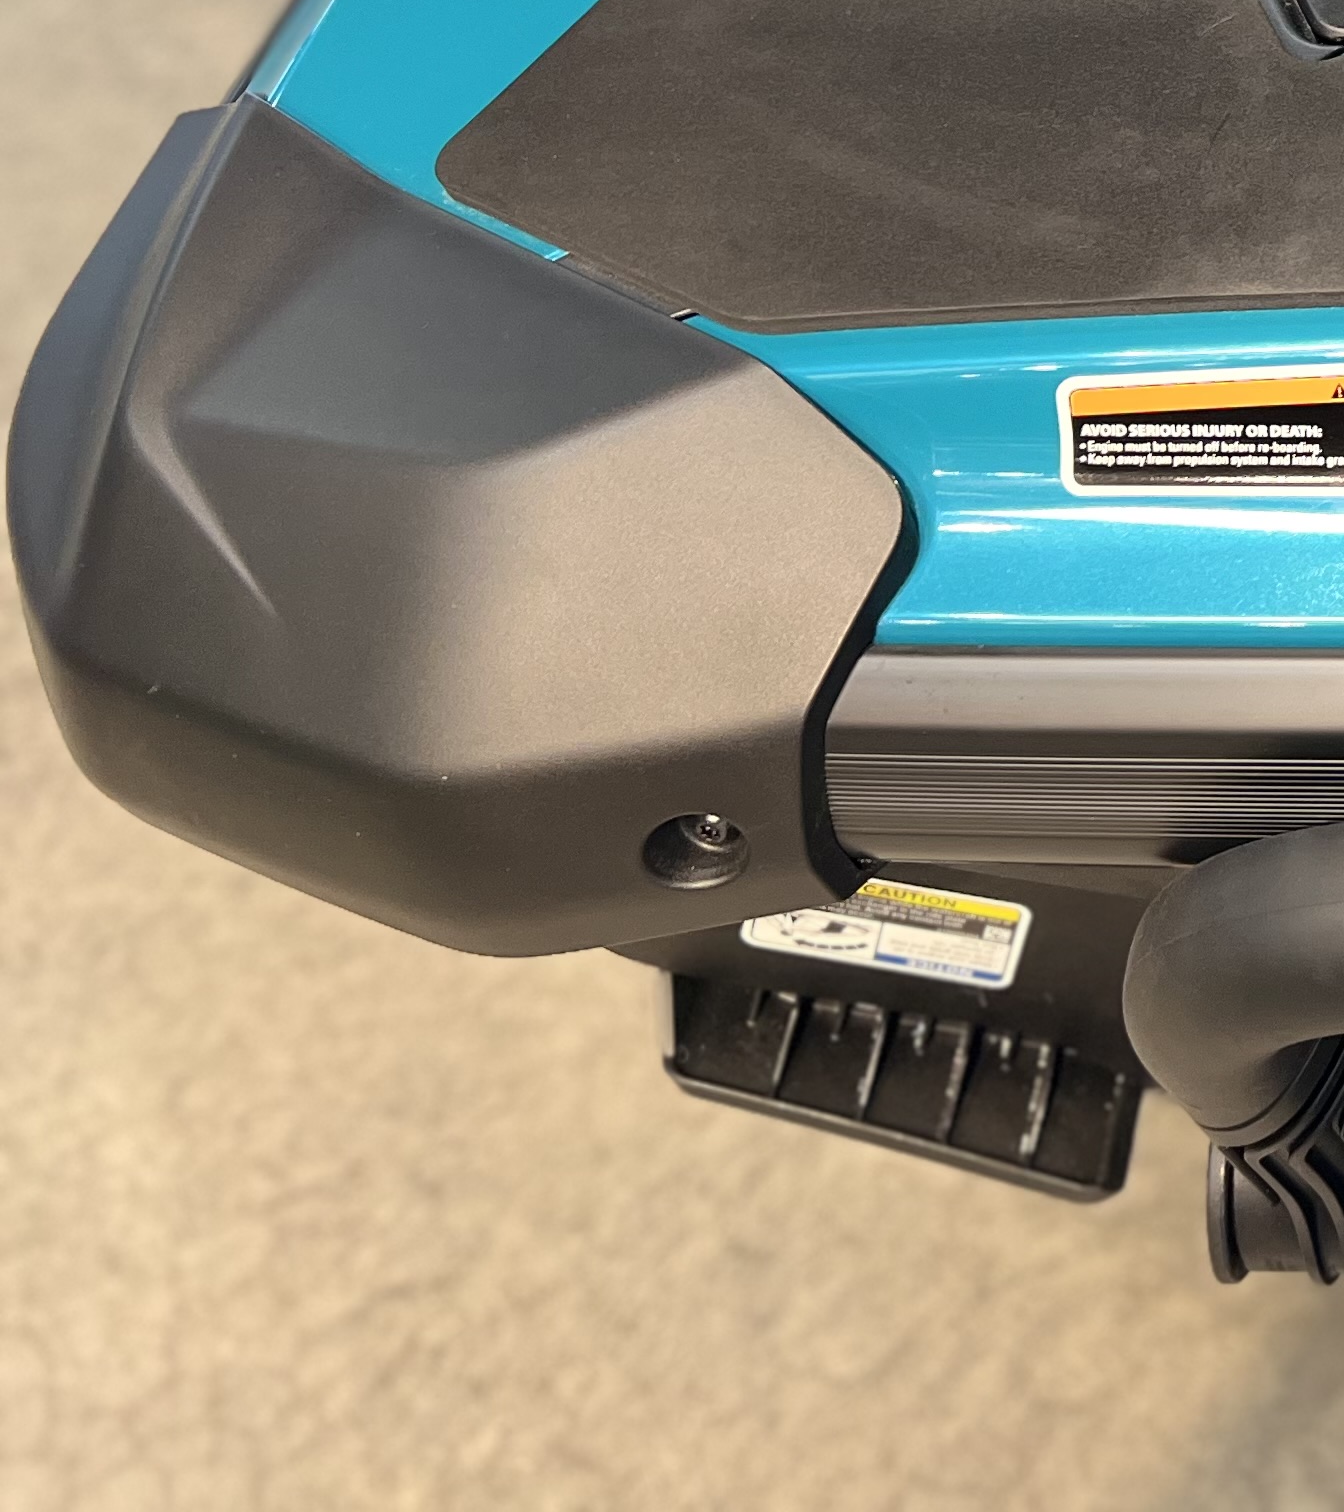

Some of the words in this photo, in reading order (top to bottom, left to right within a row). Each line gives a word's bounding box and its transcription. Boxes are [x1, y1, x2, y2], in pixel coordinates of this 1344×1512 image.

[1080, 424, 1128, 437] AVOID
[1128, 424, 1191, 438] SERIOUS
[1191, 425, 1244, 438] INJURY
[1245, 425, 1269, 438] OR
[1269, 425, 1323, 438] DEATH:
[1087, 440, 1124, 454] Engine
[1124, 442, 1152, 453] must
[1152, 441, 1167, 453] be
[1168, 441, 1204, 453] turned
[1204, 440, 1220, 453] off
[1220, 441, 1256, 454] before
[1088, 453, 1116, 467] Keep
[1116, 456, 1146, 467] away
[1147, 453, 1172, 465] from
[1230, 455, 1269, 468] system
[1269, 454, 1291, 466] and
[863, 884, 957, 908] CAUTION
